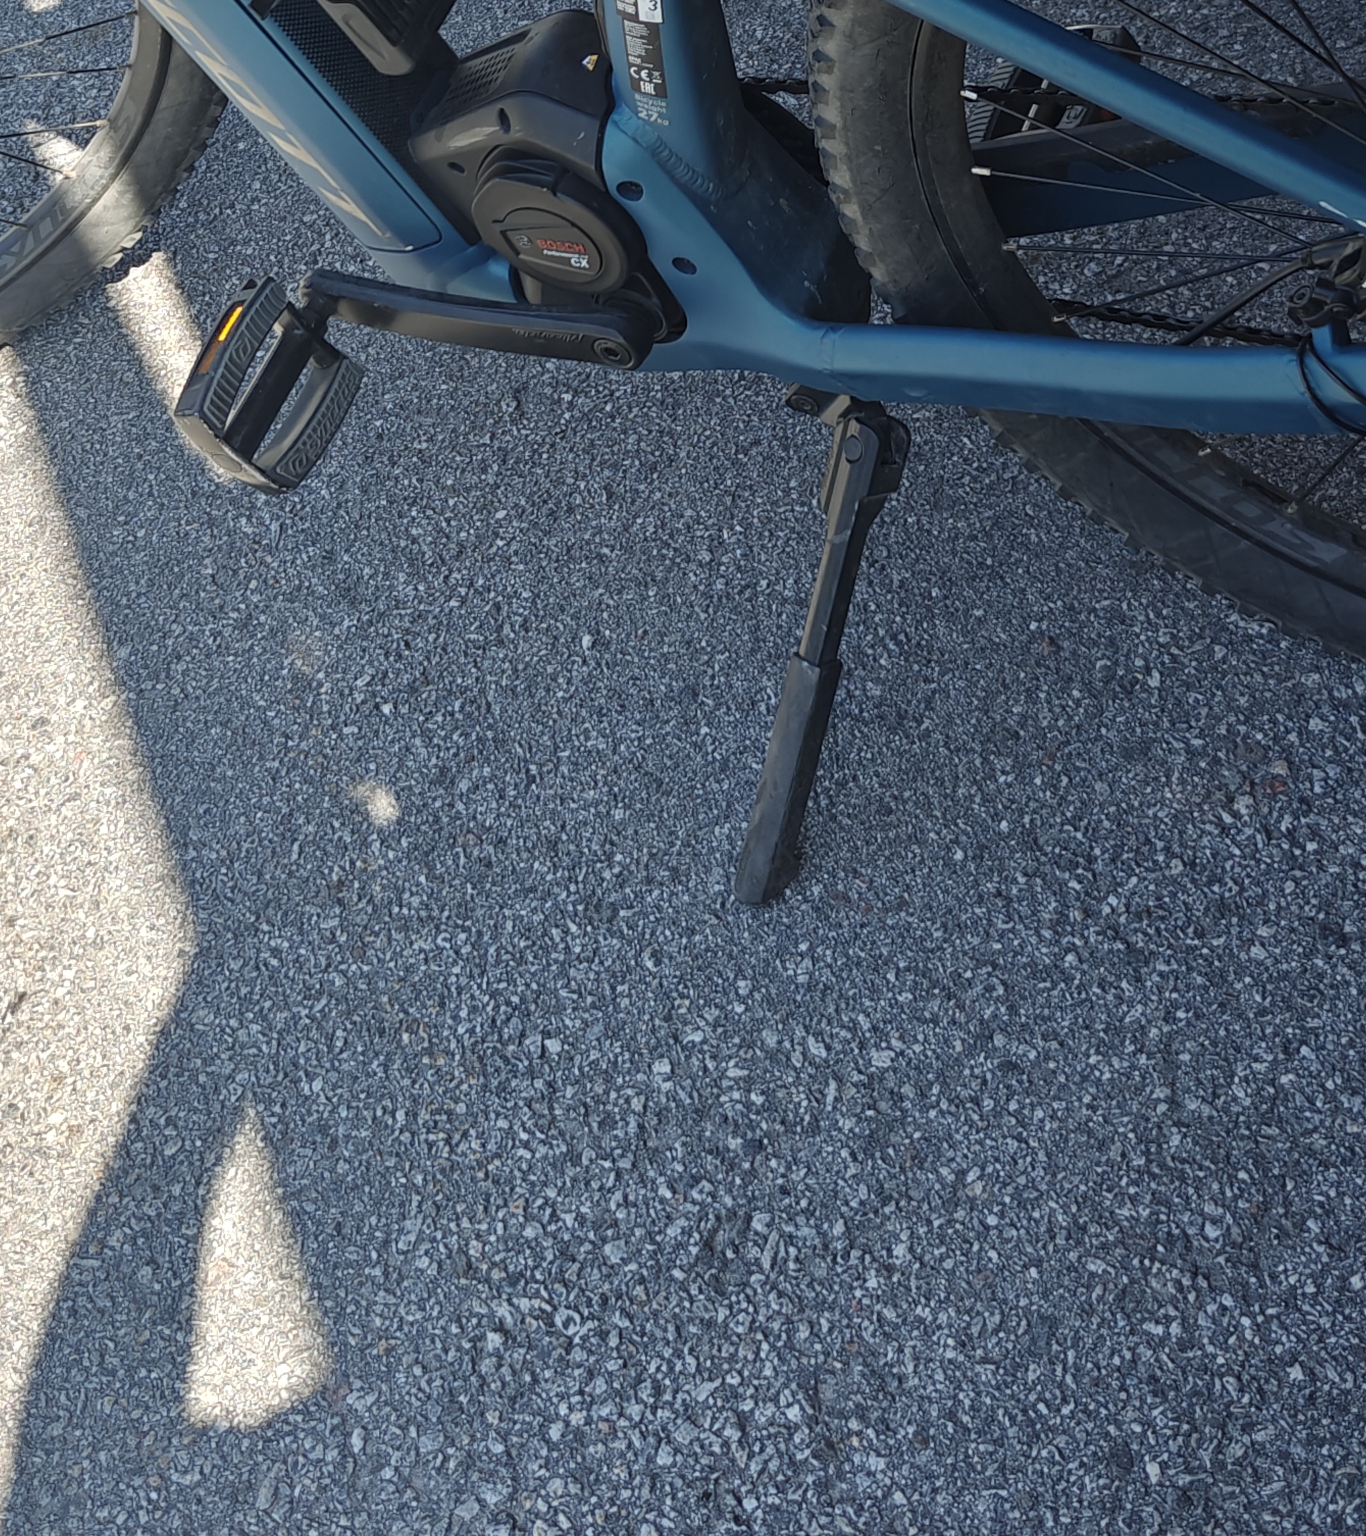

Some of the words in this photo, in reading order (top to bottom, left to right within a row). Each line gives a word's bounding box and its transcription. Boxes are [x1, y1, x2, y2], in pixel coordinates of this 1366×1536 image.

[647, 0, 657, 11] 3
[536, 238, 585, 252] BOSCH
[569, 257, 589, 268] CX
